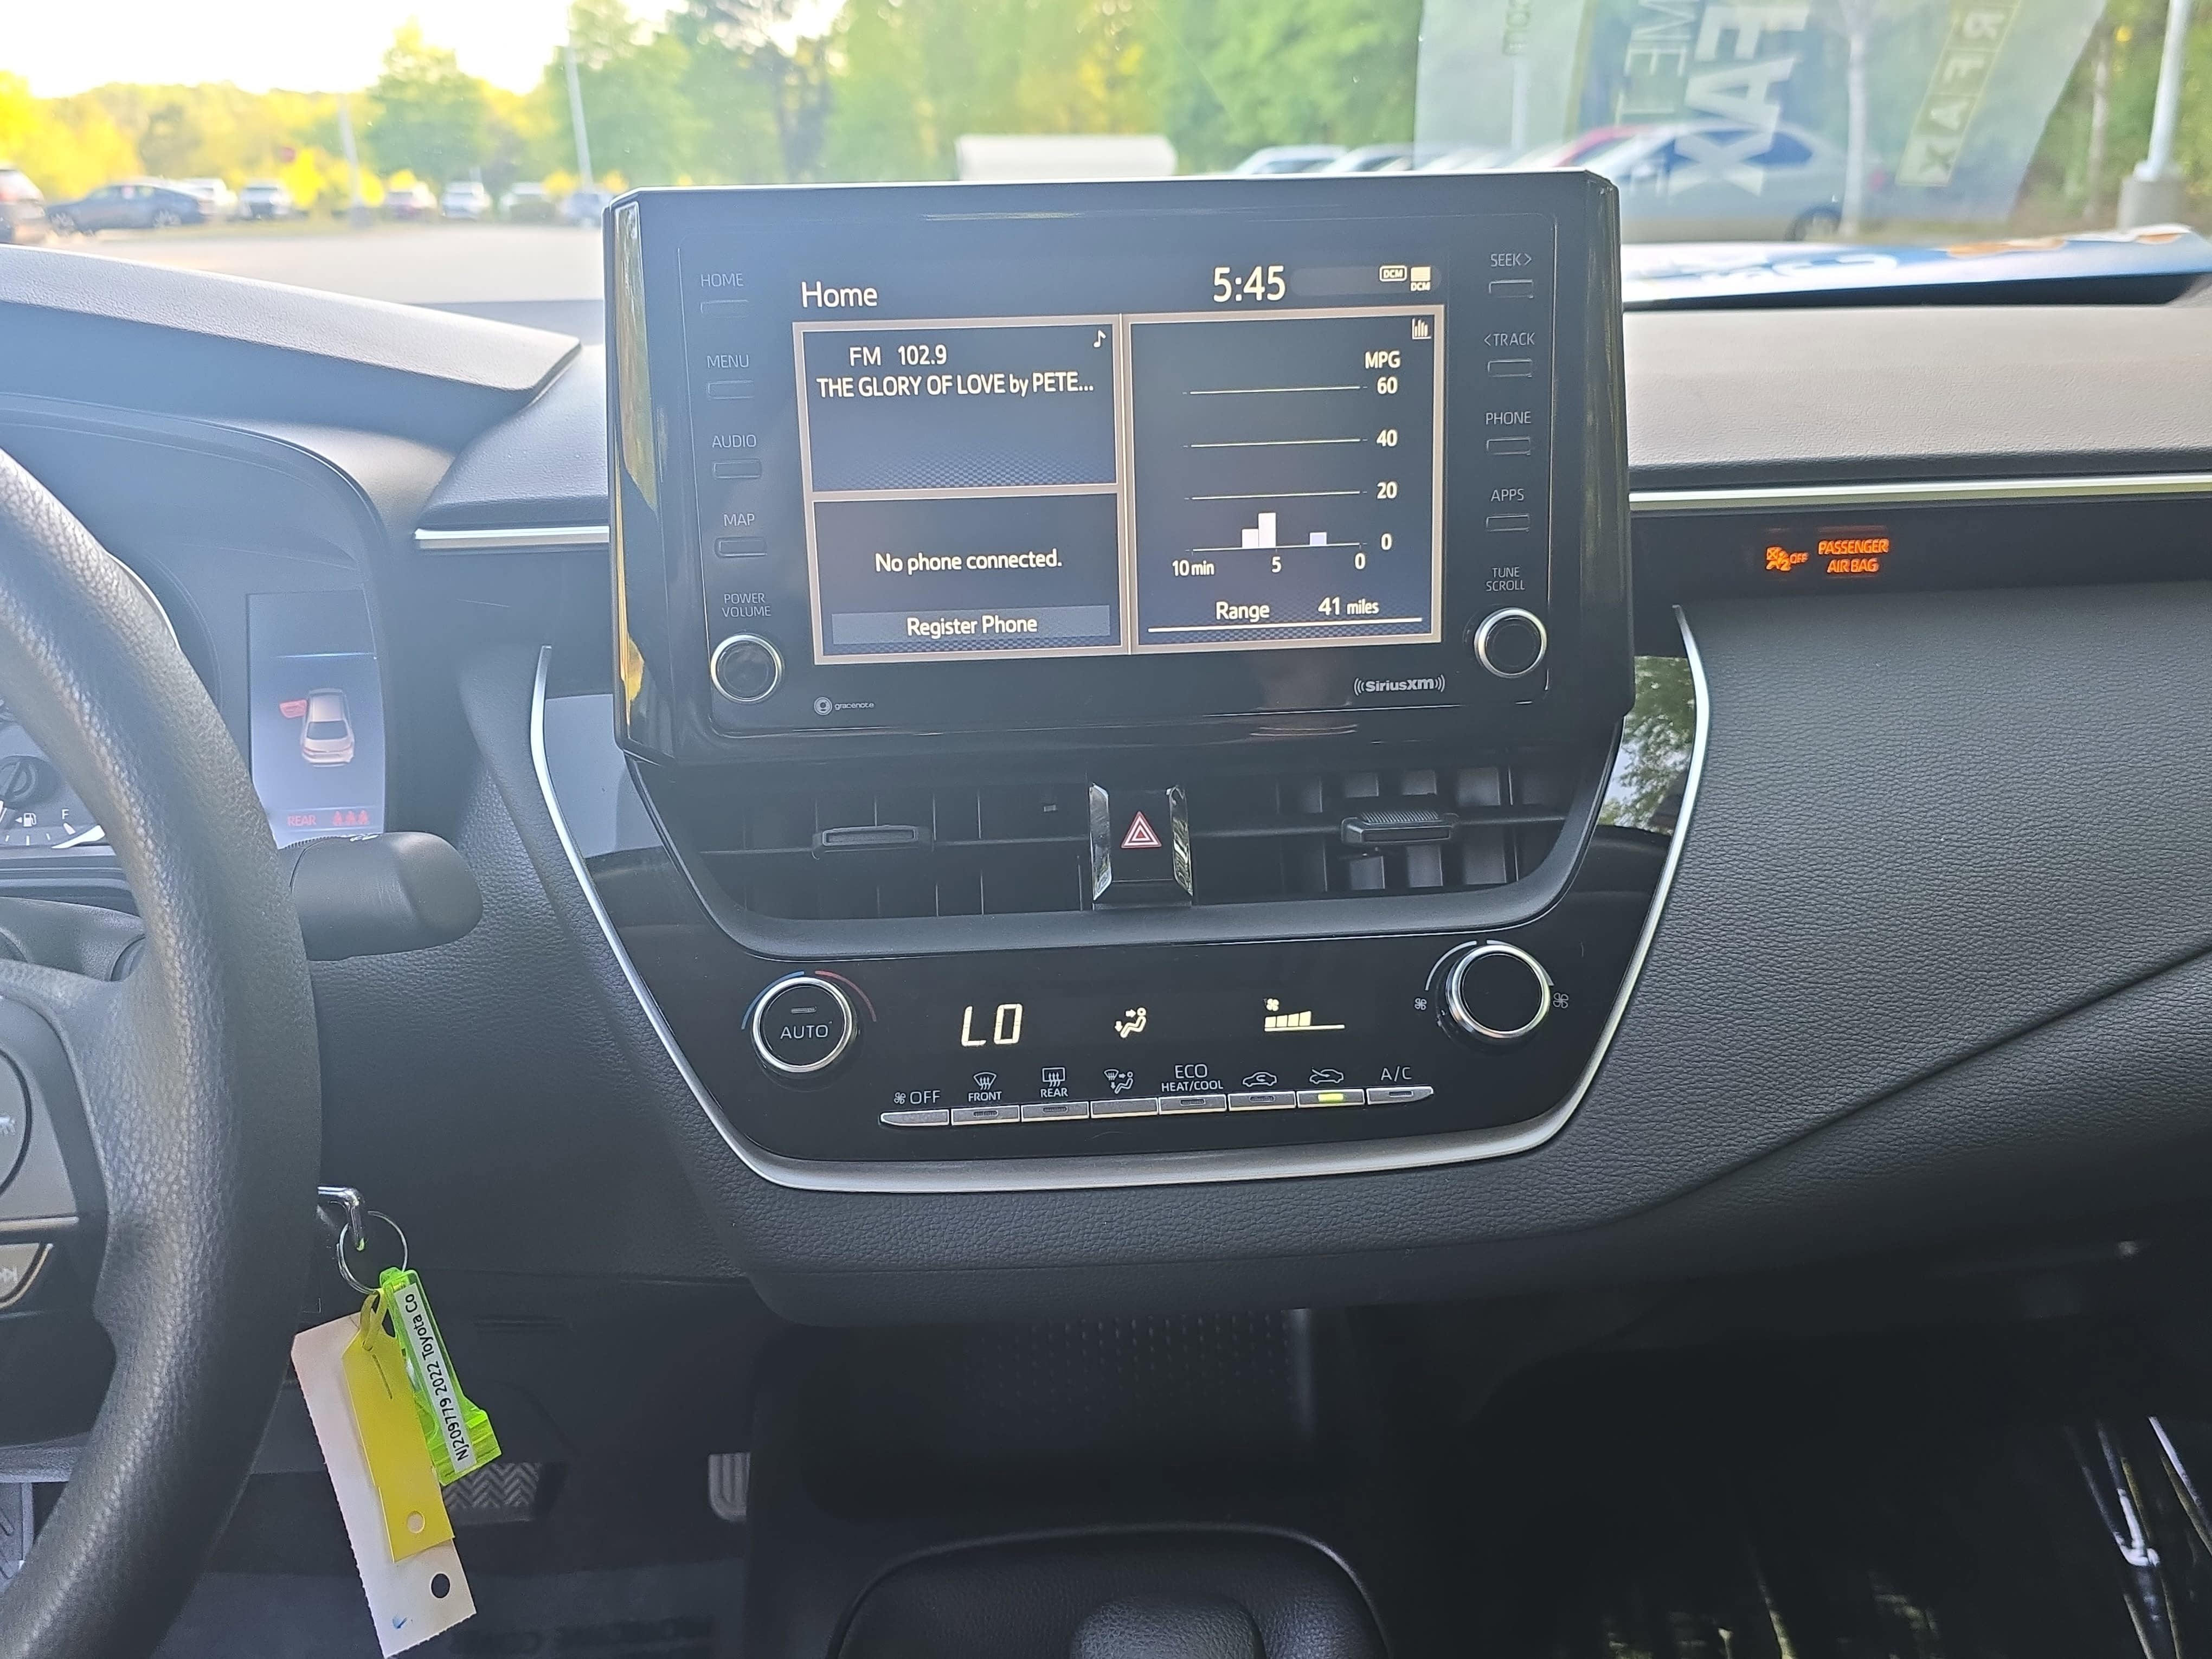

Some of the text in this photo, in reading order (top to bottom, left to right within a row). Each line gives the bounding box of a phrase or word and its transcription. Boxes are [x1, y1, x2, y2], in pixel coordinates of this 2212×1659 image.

[1490, 253, 1521, 267] SEEK
[700, 273, 744, 287] HOME
[1383, 269, 1403, 279] DCM
[1213, 265, 1287, 303] 5:45
[1410, 281, 1431, 291] DCM
[801, 281, 878, 307] Home
[1493, 332, 1535, 346] TRACK
[707, 354, 749, 368] MENU
[849, 344, 947, 366] FM 102.9
[1365, 350, 1401, 369] MPG
[816, 371, 1094, 398] THE GLORY OF LOVE by PETE...
[1377, 376, 1398, 395] 60
[1486, 410, 1532, 425] PHONE
[712, 434, 757, 448] AUDIO
[1376, 429, 1398, 447] 40
[1377, 481, 1398, 499] 20
[1490, 488, 1525, 501] APPS
[723, 513, 755, 526] MAP
[1380, 533, 1393, 551] 0
[1818, 538, 1890, 555] PASSENGER
[874, 548, 1062, 575] No phone connected.
[1271, 557, 1282, 573] 5
[1354, 552, 1366, 570] 0
[1790, 552, 1809, 564] OFF
[1172, 560, 1215, 576] 10 min
[1492, 566, 1520, 578] TUNE
[1486, 580, 1525, 592] SCROLL
[724, 593, 766, 604] POWER
[722, 606, 771, 618] VOLUME
[1216, 597, 1380, 622] Range 41 miles
[906, 614, 1038, 639] Register Phone
[834, 702, 874, 711] gracenote
[61, 808, 69, 820] F
[287, 815, 317, 826] REAR
[780, 1024, 829, 1040] AUTO
[1174, 1063, 1209, 1079] ECO
[1380, 1065, 1412, 1083] A/C
[1040, 1087, 1069, 1098] REAR
[1161, 1078, 1224, 1092] HEAT/COOL
[910, 1090, 942, 1105] OFF
[968, 1090, 1002, 1102] FRONT
[405, 1293, 470, 1462] NJ209779 2022 Toyota Co
